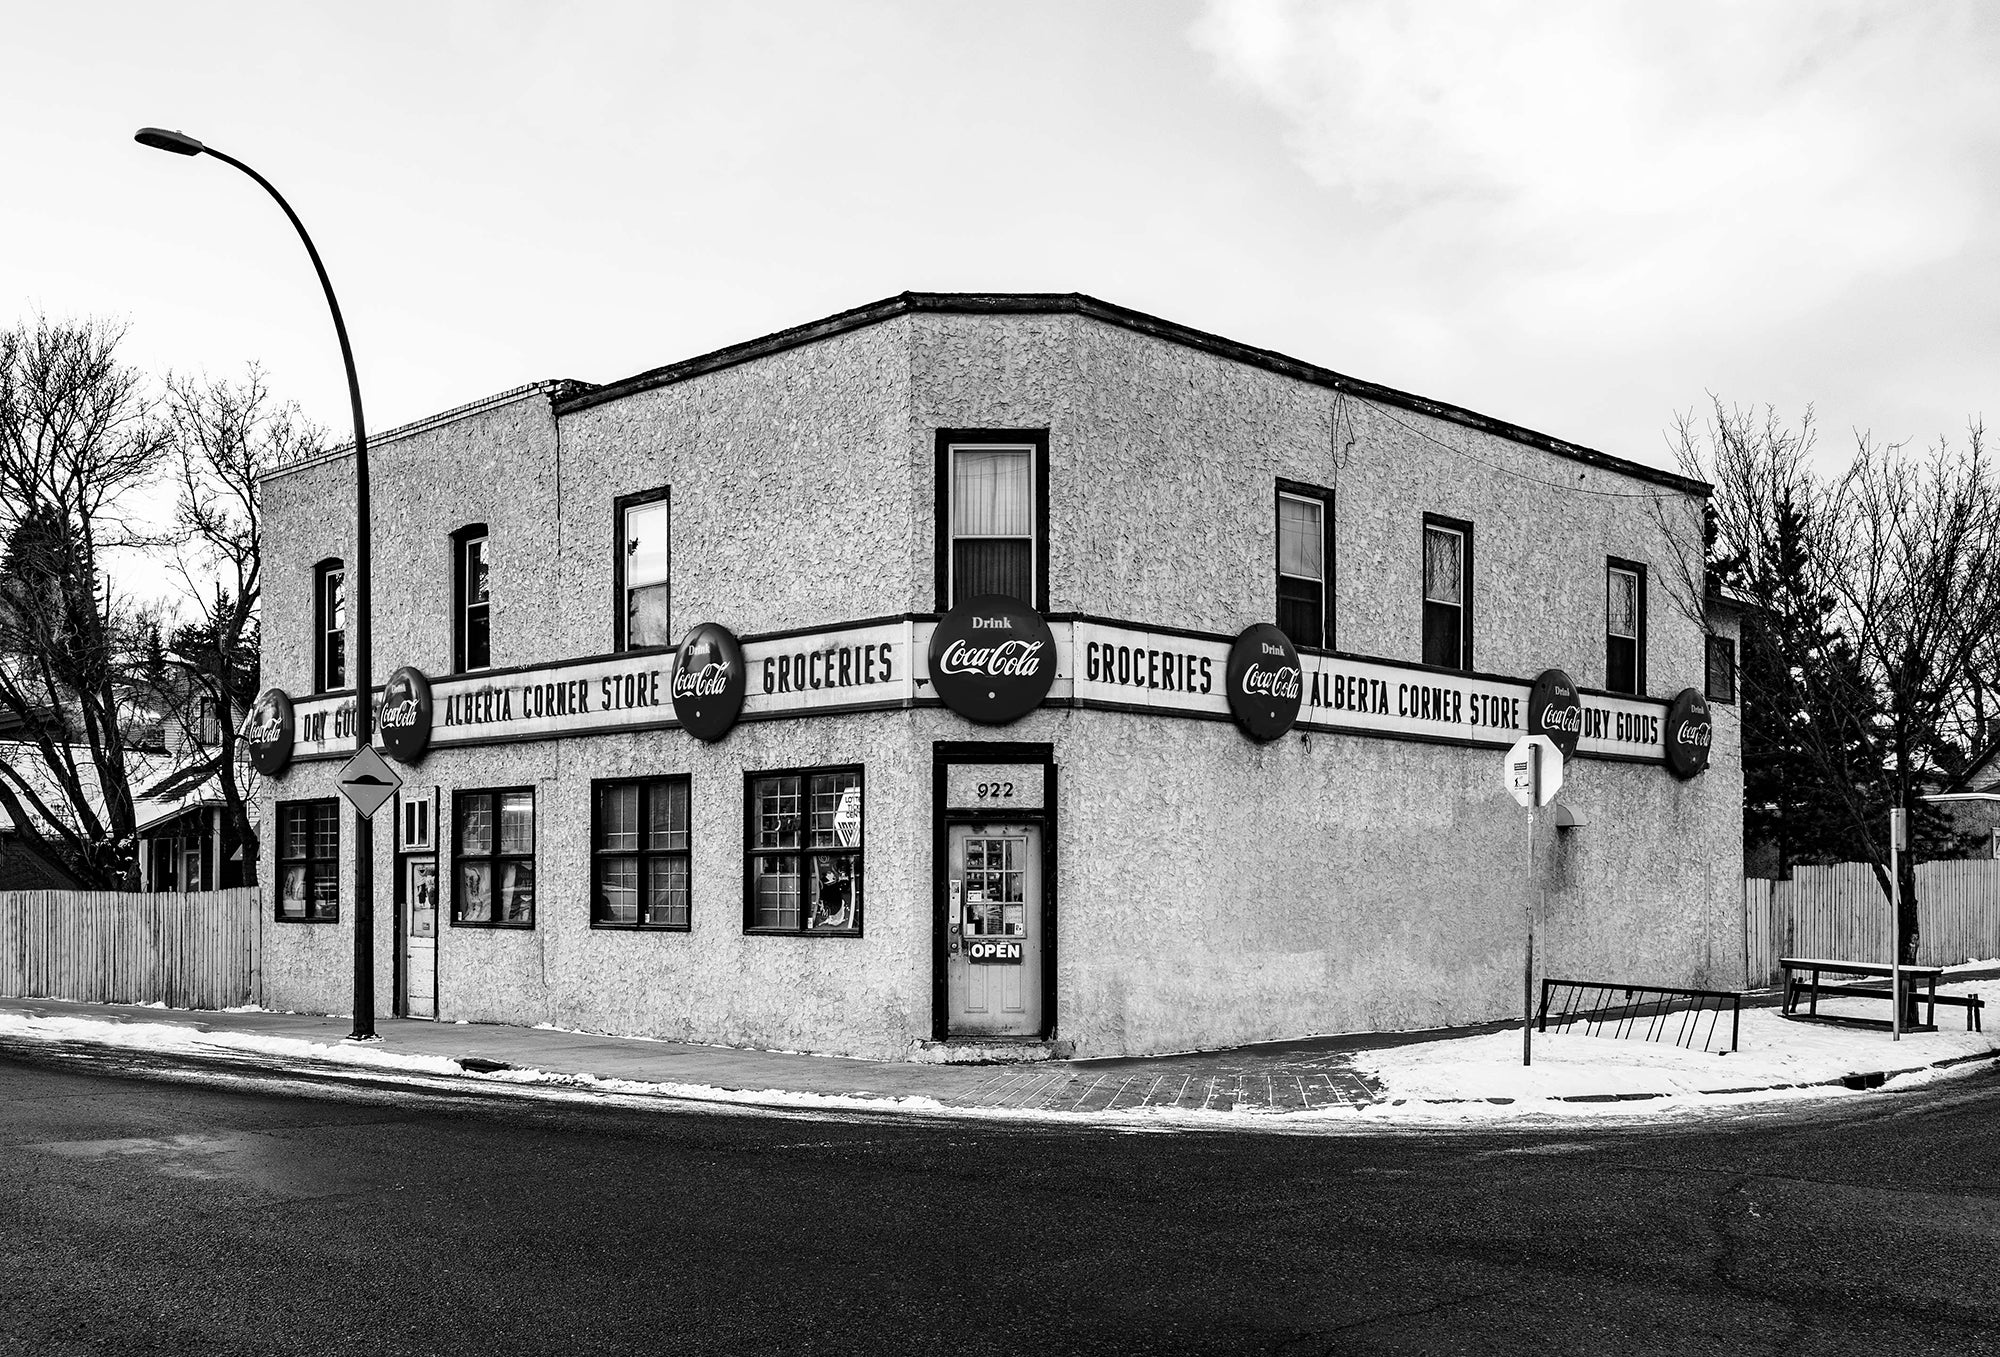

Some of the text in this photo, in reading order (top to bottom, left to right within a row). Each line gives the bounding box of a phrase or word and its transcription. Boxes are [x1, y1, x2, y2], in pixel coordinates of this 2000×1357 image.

[972, 617, 1012, 629] Drink
[688, 643, 711, 656] Drink
[763, 642, 892, 694] GROCERIES
[940, 639, 1045, 676] Coca-Cola
[1087, 641, 1212, 694] GROCERIES
[1262, 642, 1285, 657] Drink
[445, 670, 659, 726] ALBERTA CORNER STORE
[672, 660, 730, 699] Coca-Cola
[1242, 662, 1300, 700] Coca-Cola
[1555, 686, 1570, 697] Drink
[1309, 671, 1520, 729] ALBERTA CORNER STORE
[304, 706, 376, 742] DRY GOOS
[1585, 708, 1658, 745] DRY GOODS
[977, 782, 1013, 798] 922
[971, 943, 1020, 959] OPEN
